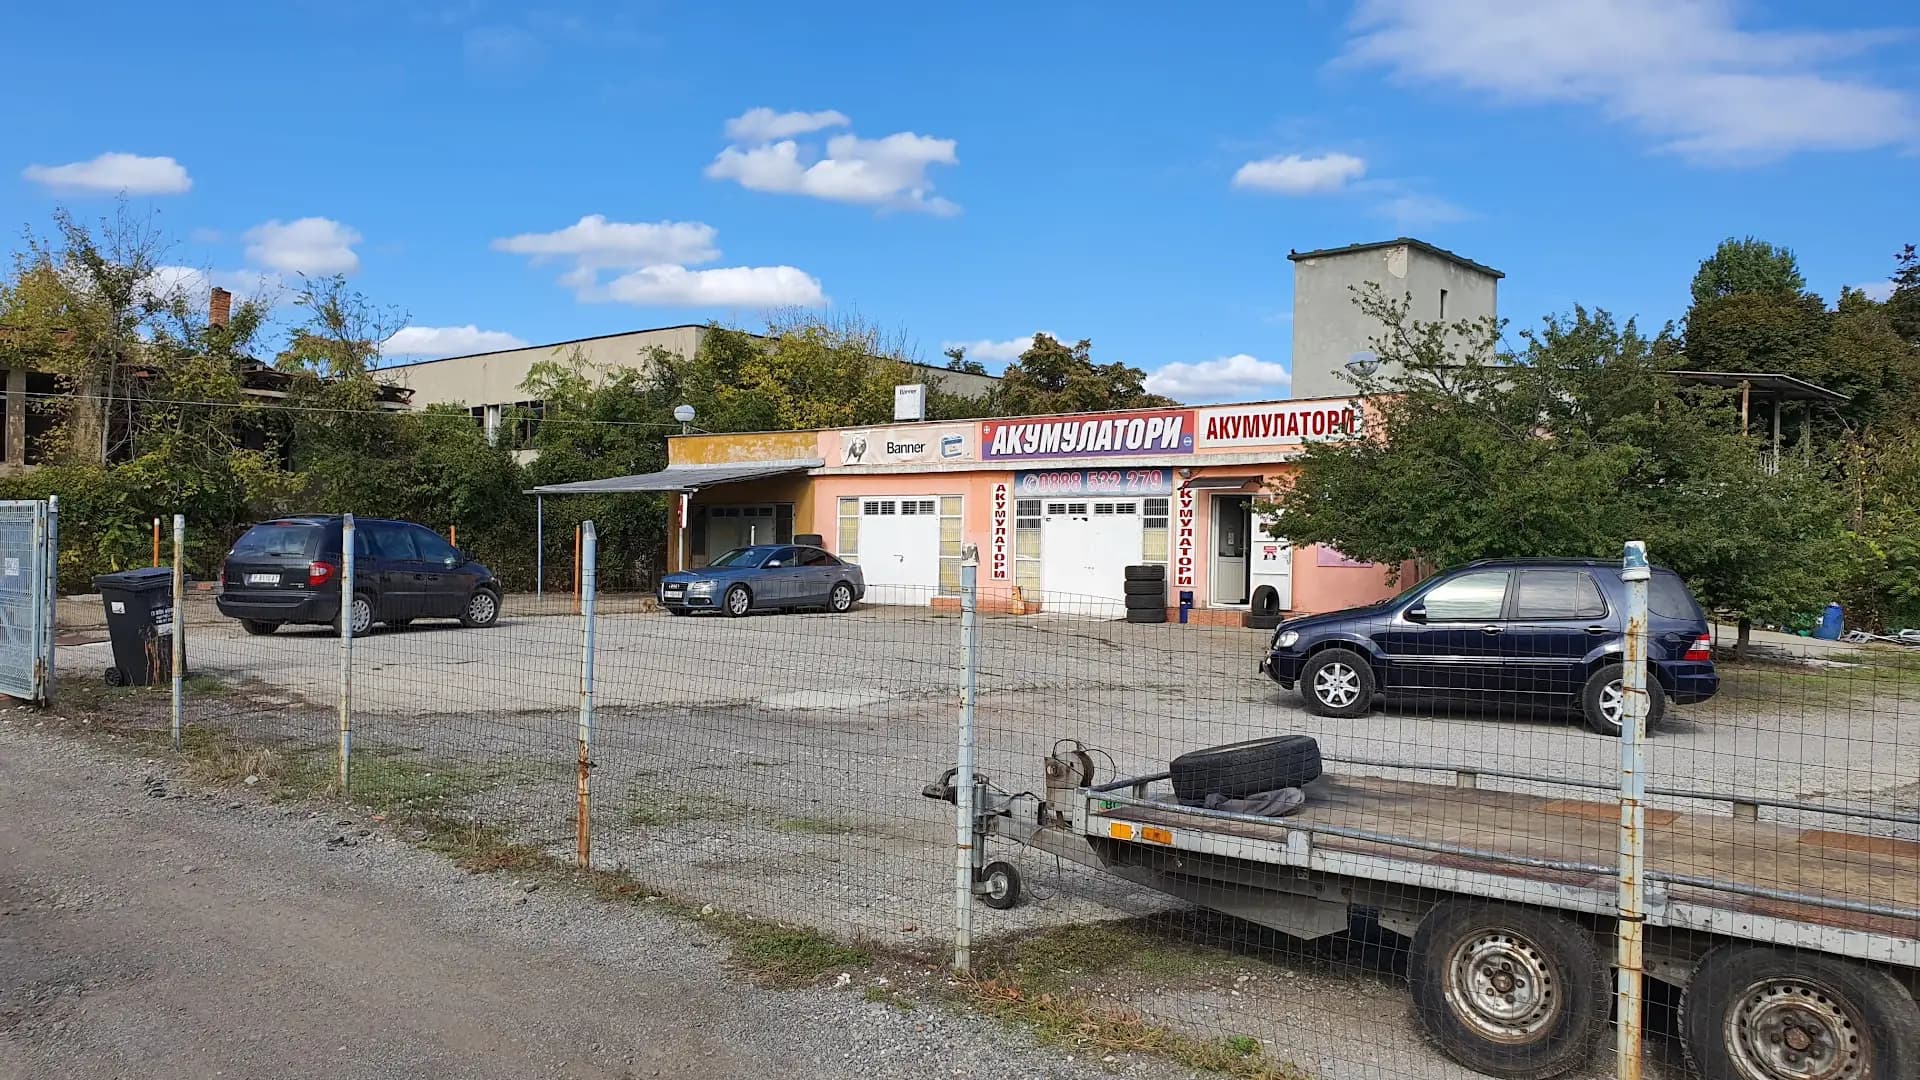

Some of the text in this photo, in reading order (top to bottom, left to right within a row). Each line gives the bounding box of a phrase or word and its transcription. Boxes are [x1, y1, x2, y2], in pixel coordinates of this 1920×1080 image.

[990, 416, 1184, 455] АКУМУЛАТОРИ
[1206, 409, 1355, 440] АКУМУЛАТОРИ
[887, 441, 926, 454] Banner
[1038, 470, 1163, 492] 0888 532 279
[994, 484, 1006, 578] АКУМУЛАТОРИ
